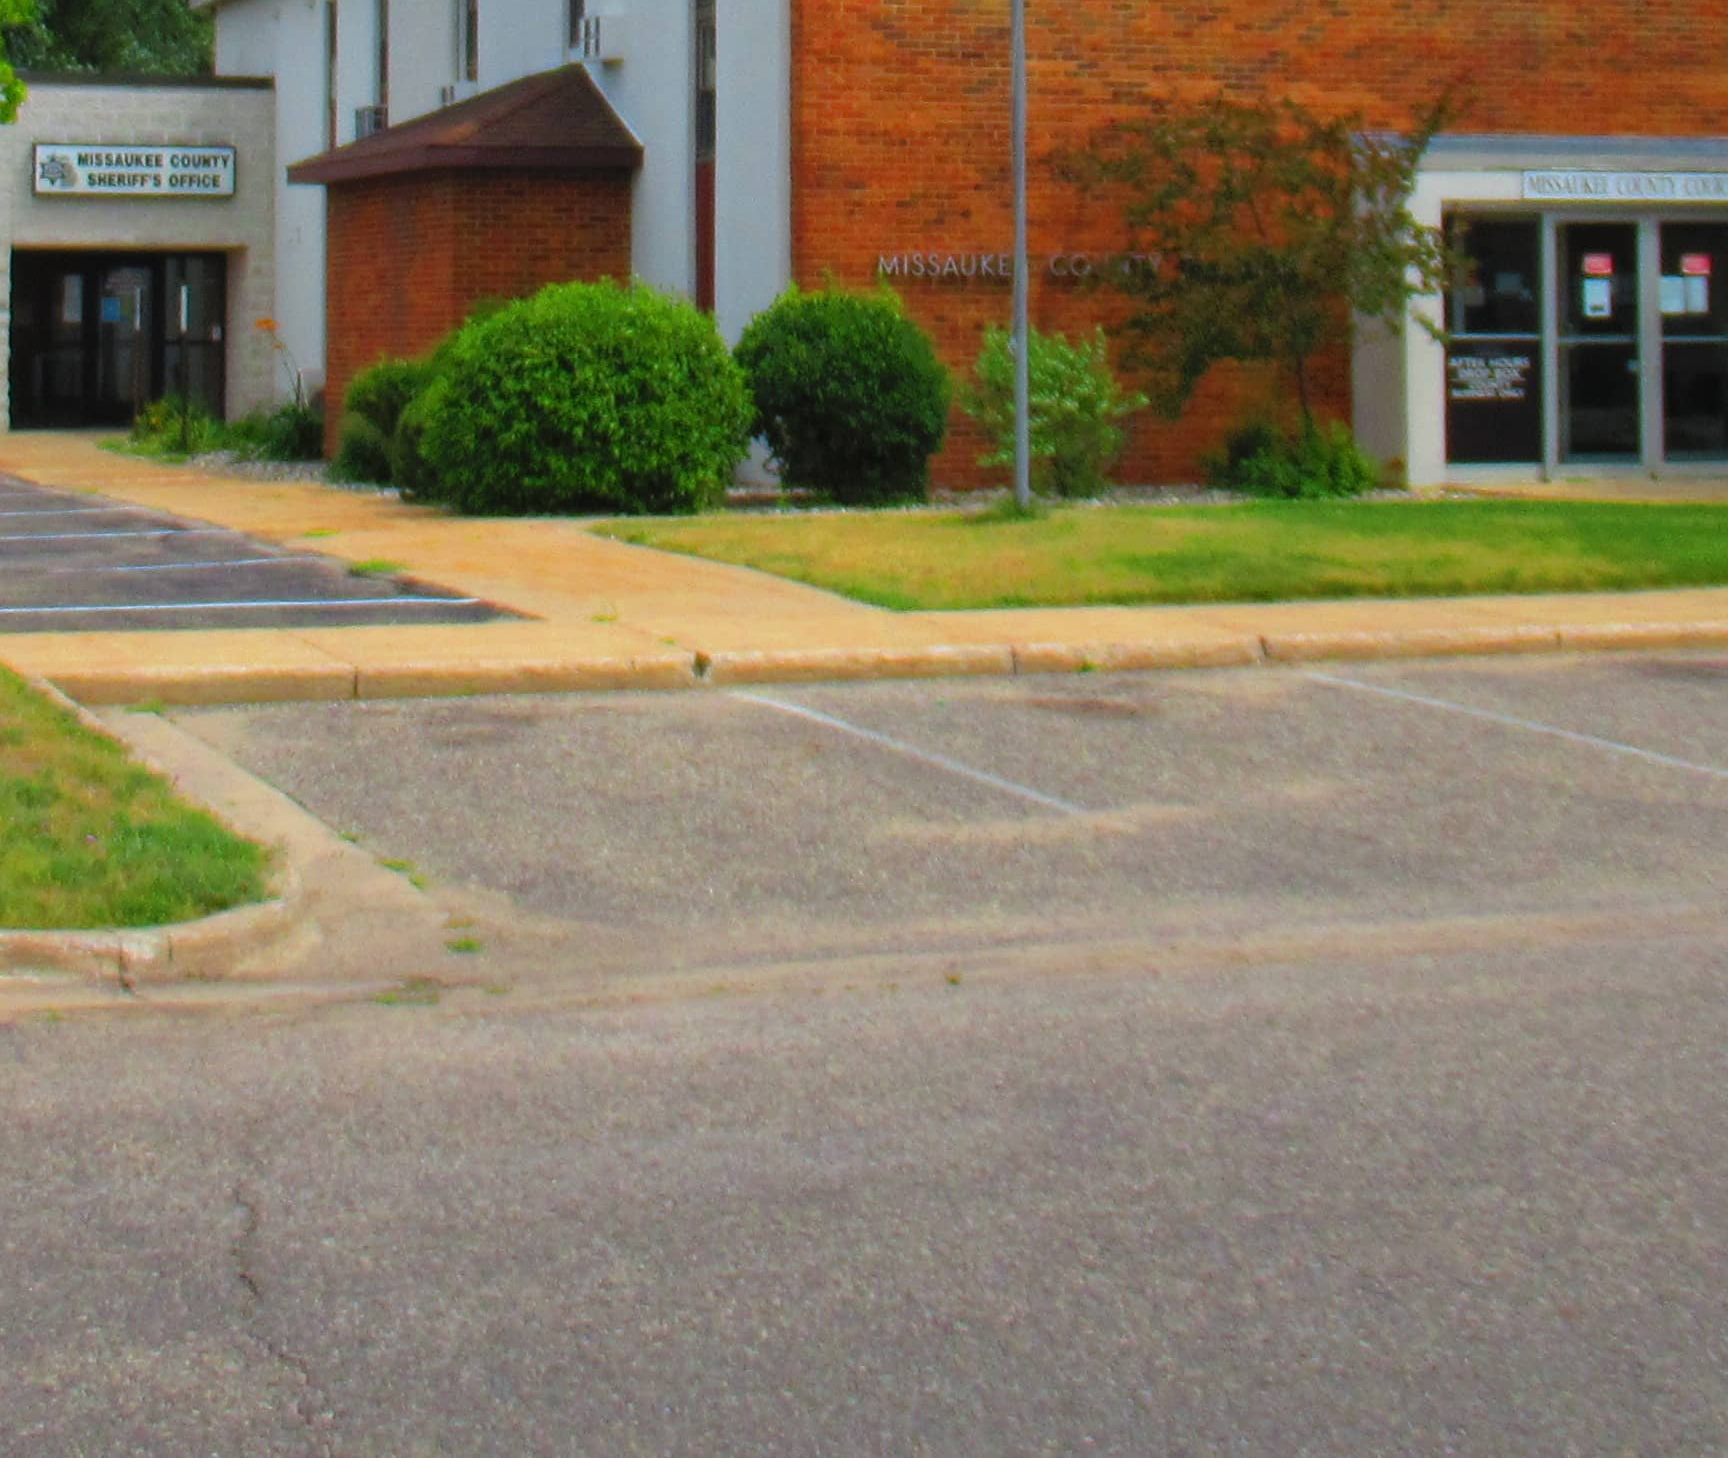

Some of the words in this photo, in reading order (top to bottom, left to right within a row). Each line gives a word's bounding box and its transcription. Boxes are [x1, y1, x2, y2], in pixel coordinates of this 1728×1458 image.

[77, 152, 163, 167] MISSAUKEE
[170, 153, 229, 168] COUNTY
[87, 172, 161, 187] SHERIFF'S
[169, 173, 221, 188] OFFICE
[1527, 175, 1607, 195] MISSAUKEE
[1616, 176, 1676, 196] COUNTY
[878, 253, 1020, 276] MISSAUKE
